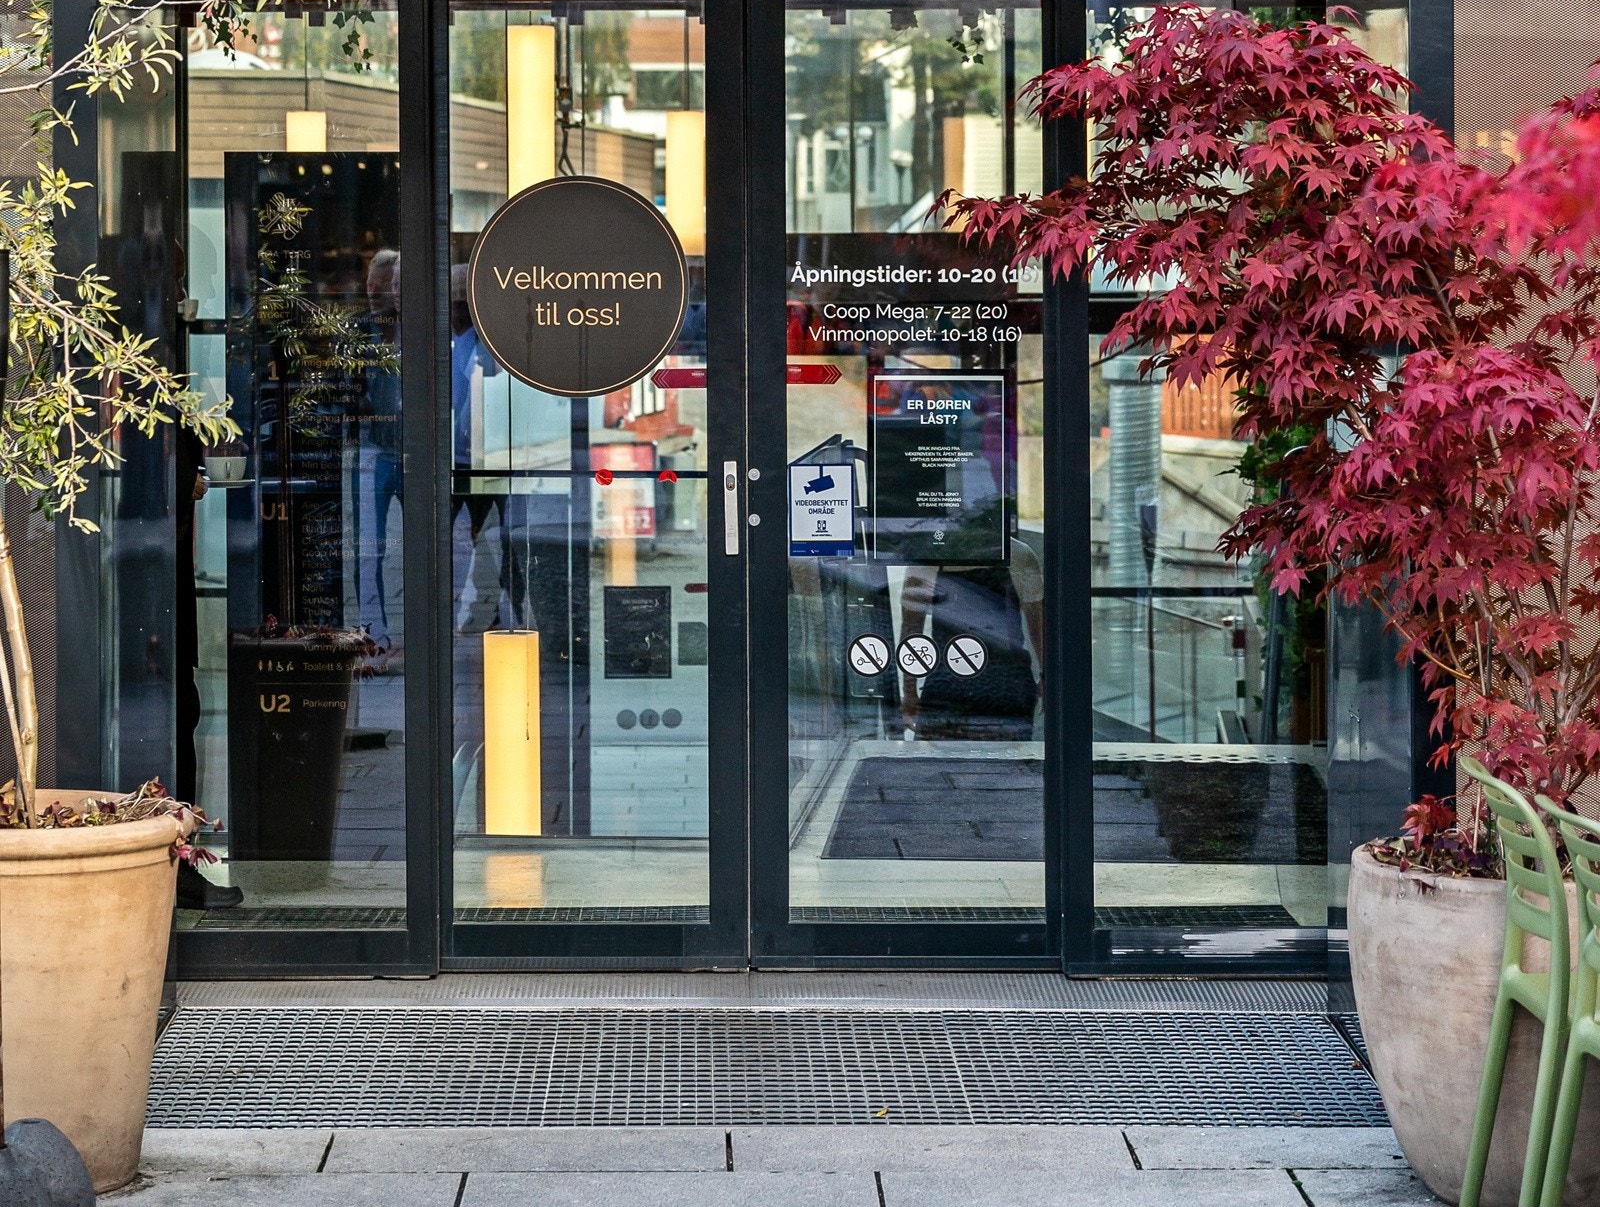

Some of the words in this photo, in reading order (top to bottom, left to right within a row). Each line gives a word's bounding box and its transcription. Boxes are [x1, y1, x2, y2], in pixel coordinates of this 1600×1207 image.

[493, 266, 662, 290] Velkommen
[791, 261, 932, 287] Åpningstider:
[938, 268, 996, 284] 10-20
[536, 302, 560, 325] til
[567, 302, 620, 326] oss!
[823, 304, 870, 322] Coop
[876, 304, 928, 322] Mega:
[933, 306, 971, 320] 7-22
[976, 303, 1008, 320] (20)
[809, 326, 936, 346] Vinmonopolet:
[941, 327, 987, 342] 10-18
[991, 325, 1022, 343] (16)
[267, 361, 279, 381] 1
[907, 400, 925, 410] ER
[927, 399, 971, 410] DØREN
[920, 414, 958, 425] LÅST?
[260, 502, 288, 521] U1
[795, 499, 849, 507] VIDEOBESKYTTET
[808, 506, 836, 515] OMRÅDE
[302, 661, 333, 671] Toalett
[259, 694, 291, 714] U2
[302, 697, 347, 712] Parkering
